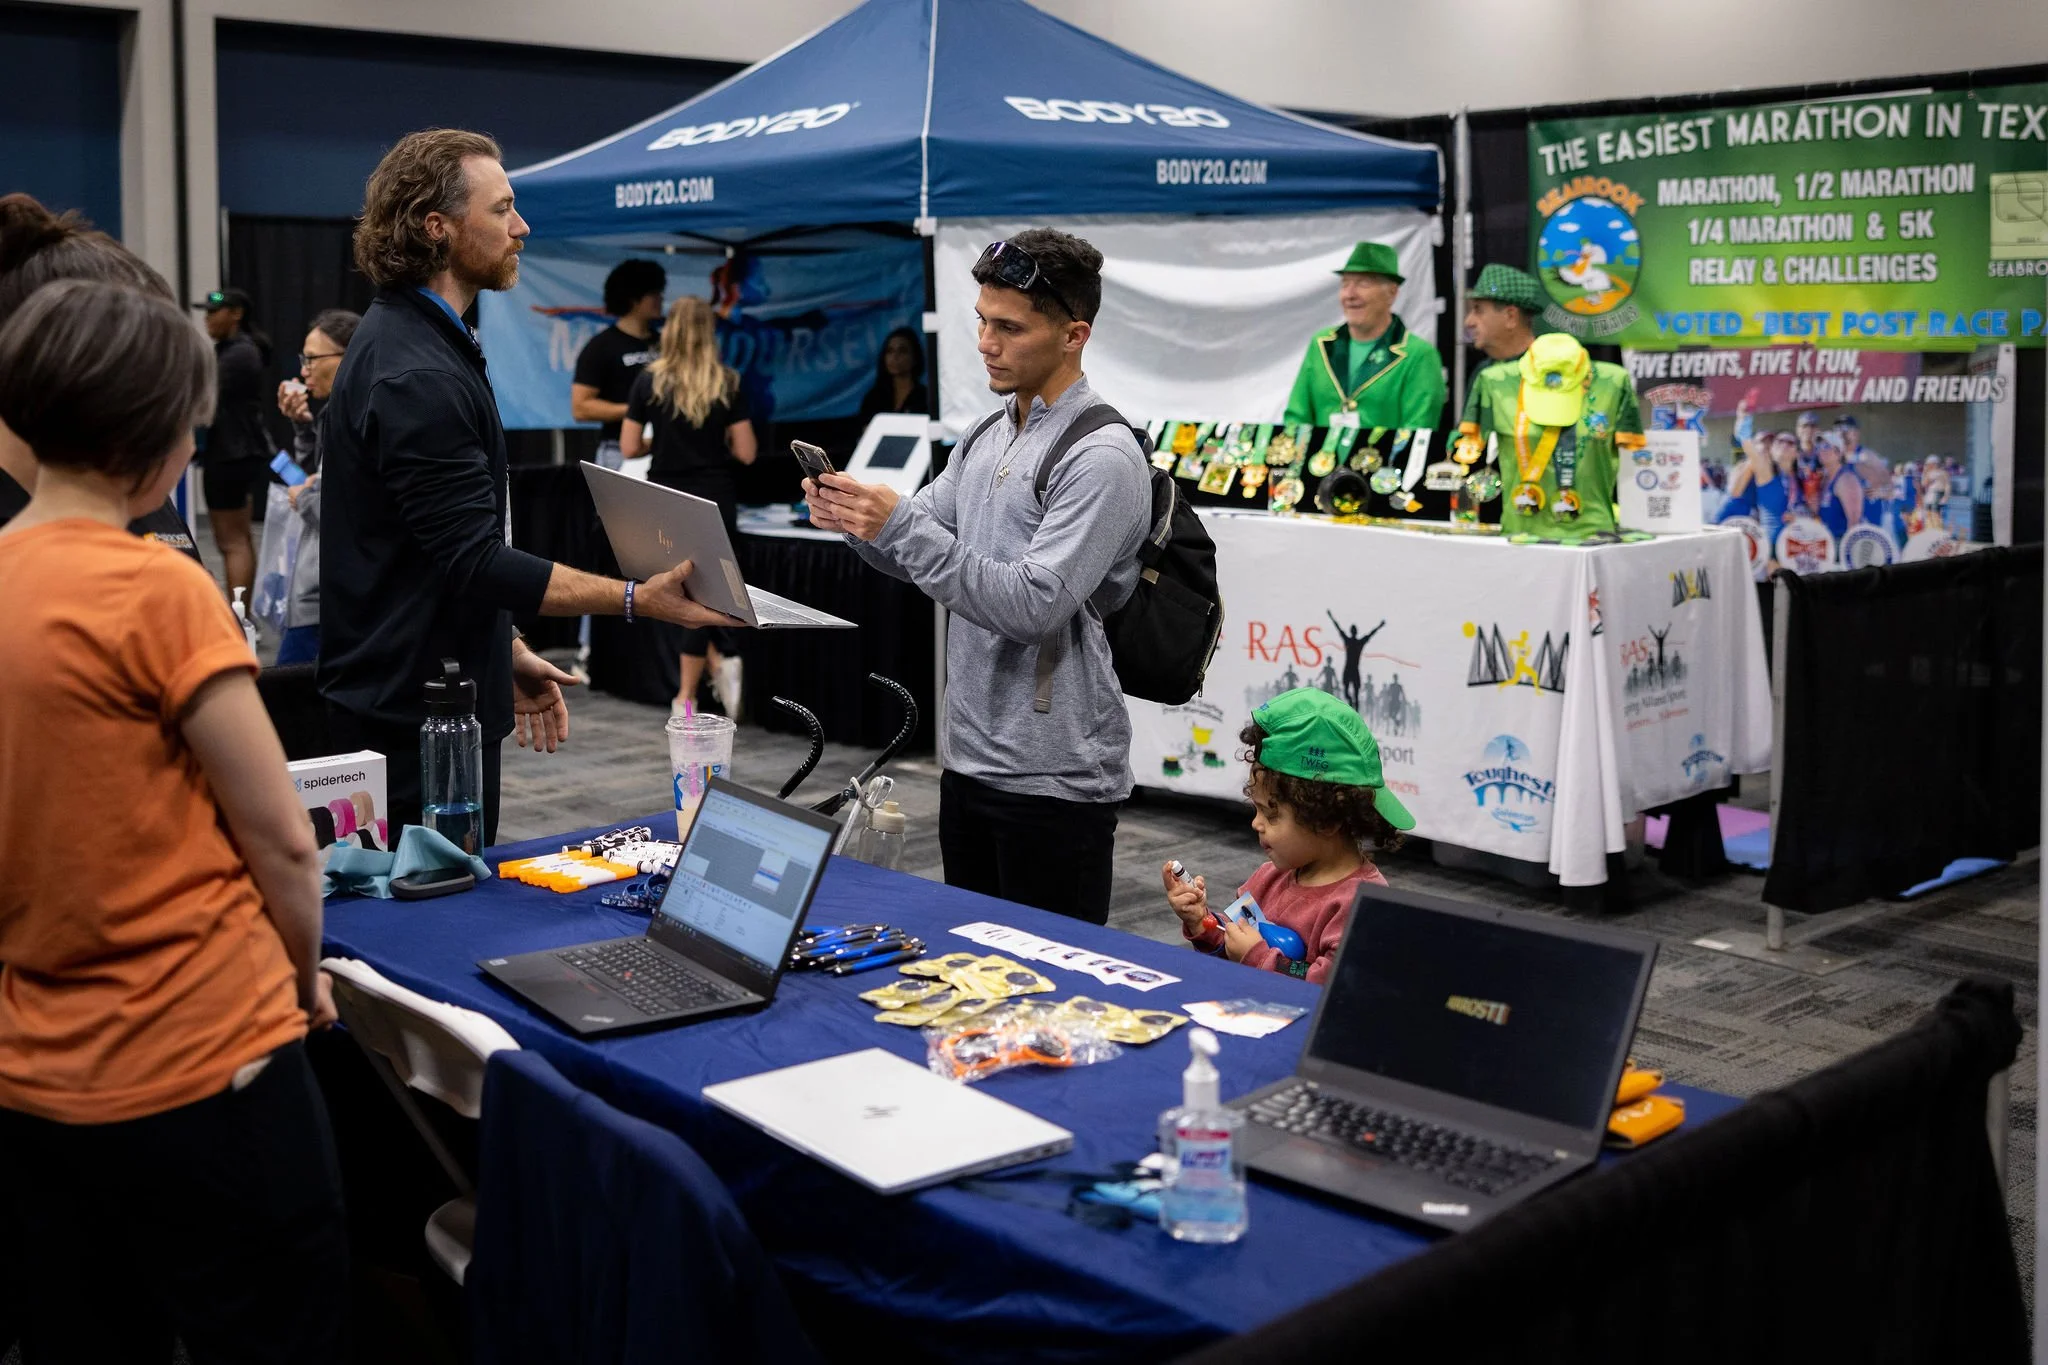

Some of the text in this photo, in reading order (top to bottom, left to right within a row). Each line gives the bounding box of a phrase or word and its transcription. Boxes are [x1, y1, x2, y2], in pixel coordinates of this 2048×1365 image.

[647, 101, 851, 150] BODY20
[1004, 96, 1230, 128] BODY20
[1538, 103, 2047, 175] THE EASIEST MARATHON IN TEX
[1156, 159, 1268, 185] BODY20.COM
[1657, 163, 1975, 207] MARATHON, 1/2 MARATHON
[615, 176, 714, 208] BODY20.COM
[1688, 209, 1935, 245] 1/4 MARATHON & 5K
[1688, 253, 1938, 286] RELAY & CHALLENGES
[1654, 311, 1742, 336] VOTED
[1632, 348, 1862, 380] FIVE EVENTS, FIVE K FUN,
[1789, 375, 2006, 403] FAMILY AND FRIENDS
[1247, 621, 1323, 667] RAS
[1380, 742, 1414, 767] port
[303, 771, 366, 790] spidertech
